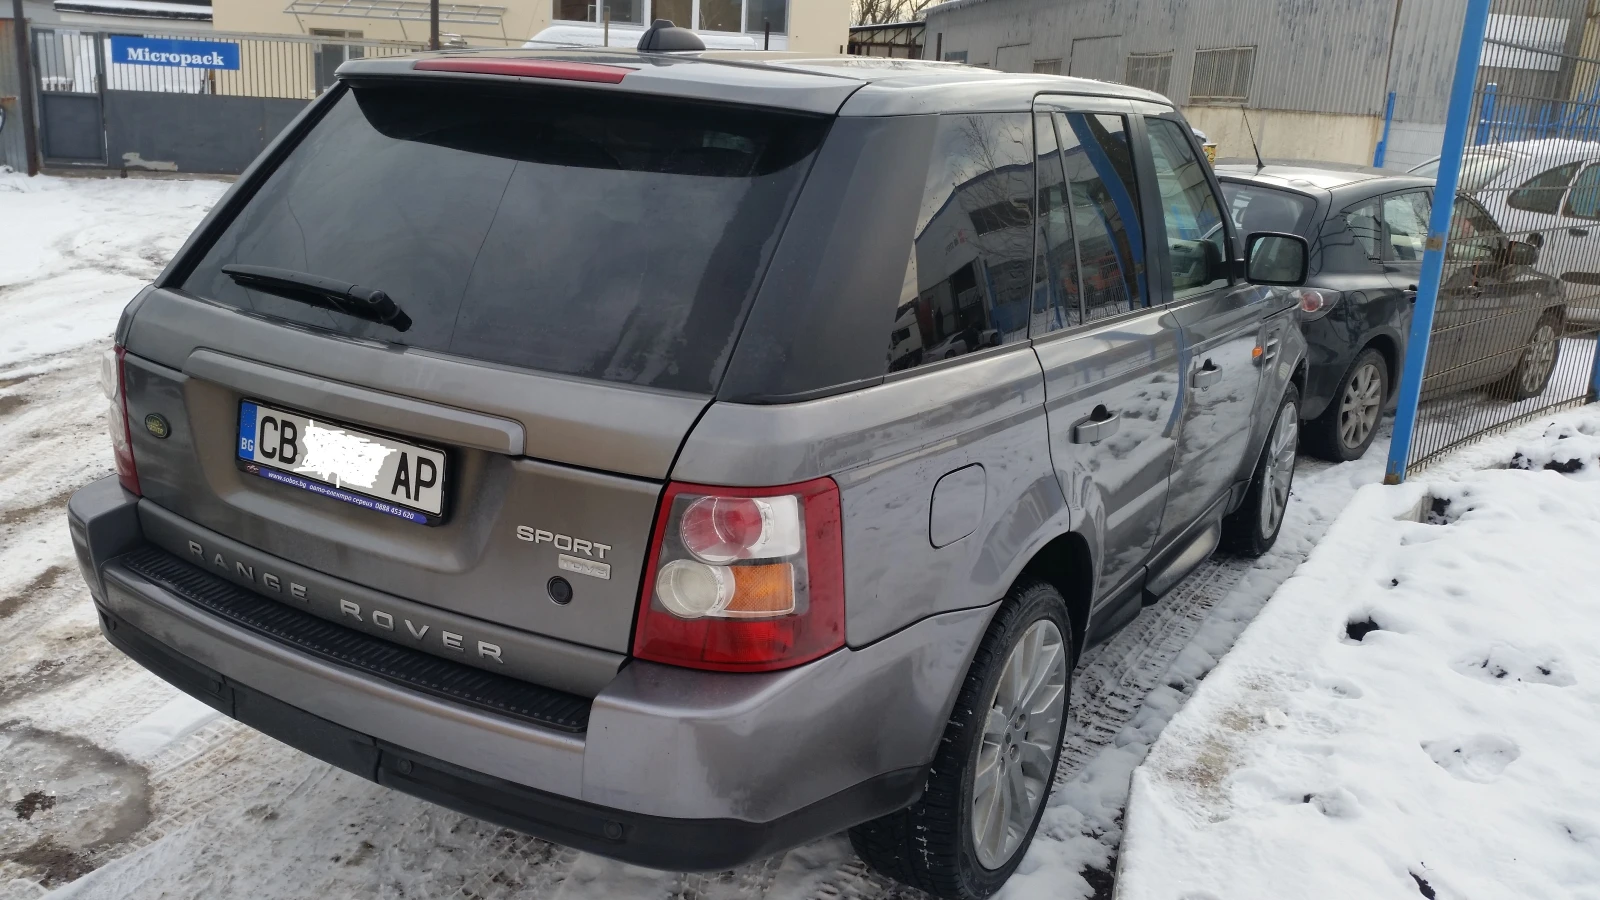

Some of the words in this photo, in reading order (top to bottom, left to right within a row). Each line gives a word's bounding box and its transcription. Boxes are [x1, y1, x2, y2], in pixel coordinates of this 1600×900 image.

[127, 47, 224, 66] Micropack
[241, 437, 254, 452] BG
[259, 415, 298, 464] CB
[391, 451, 437, 501] AP
[375, 502, 390, 513] 0888
[390, 507, 402, 516] 453
[402, 510, 415, 520] 620
[516, 525, 612, 559] SPORT
[188, 540, 309, 601] RANGE
[340, 598, 504, 664] ROVER
